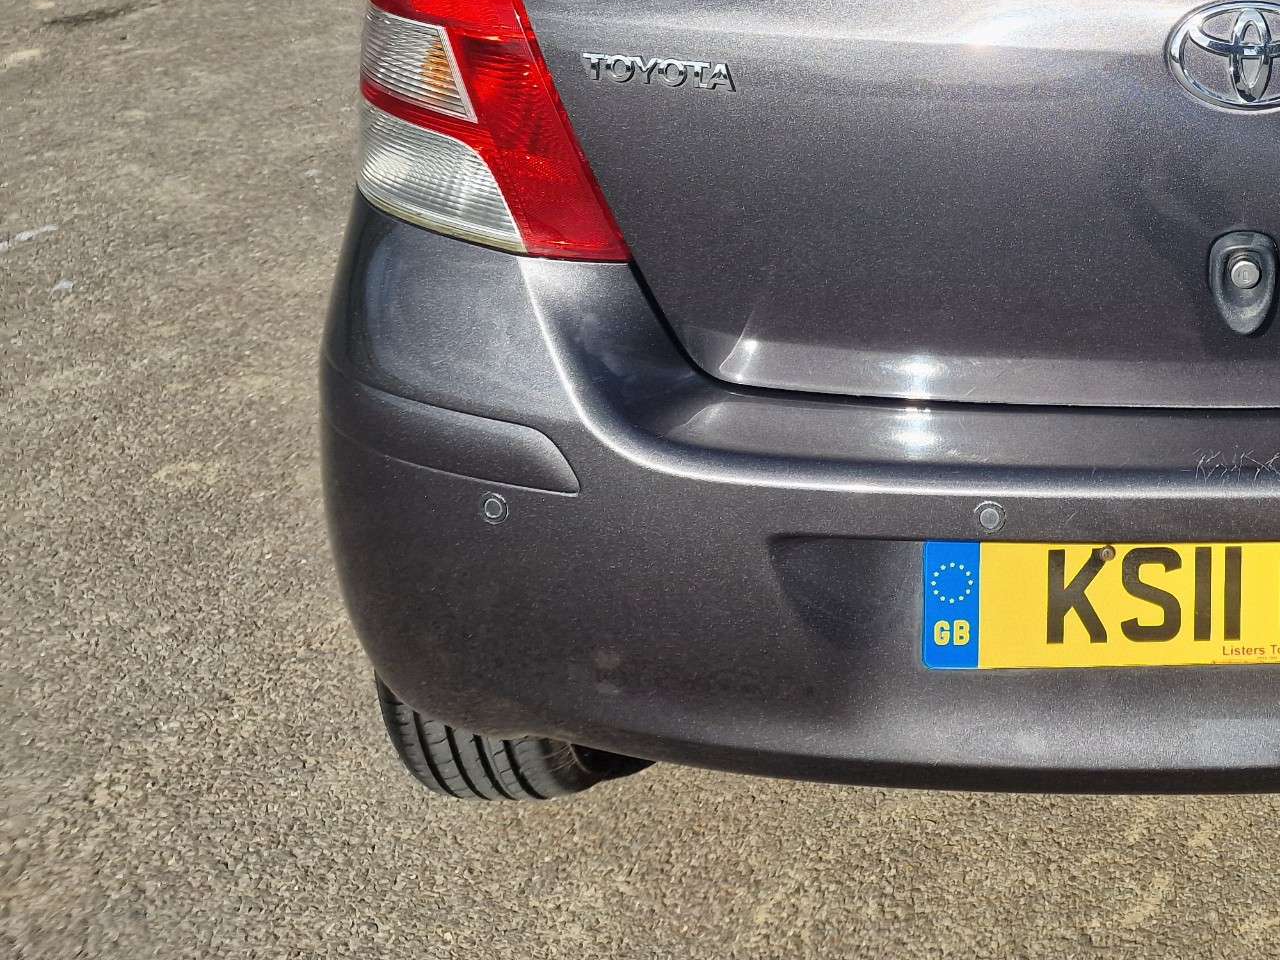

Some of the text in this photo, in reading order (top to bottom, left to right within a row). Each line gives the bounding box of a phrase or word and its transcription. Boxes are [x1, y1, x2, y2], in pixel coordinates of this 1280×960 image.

[582, 52, 737, 92] TOYOTA
[1046, 544, 1241, 645] KS11
[933, 619, 971, 646] GB
[1222, 645, 1265, 656] Listers
